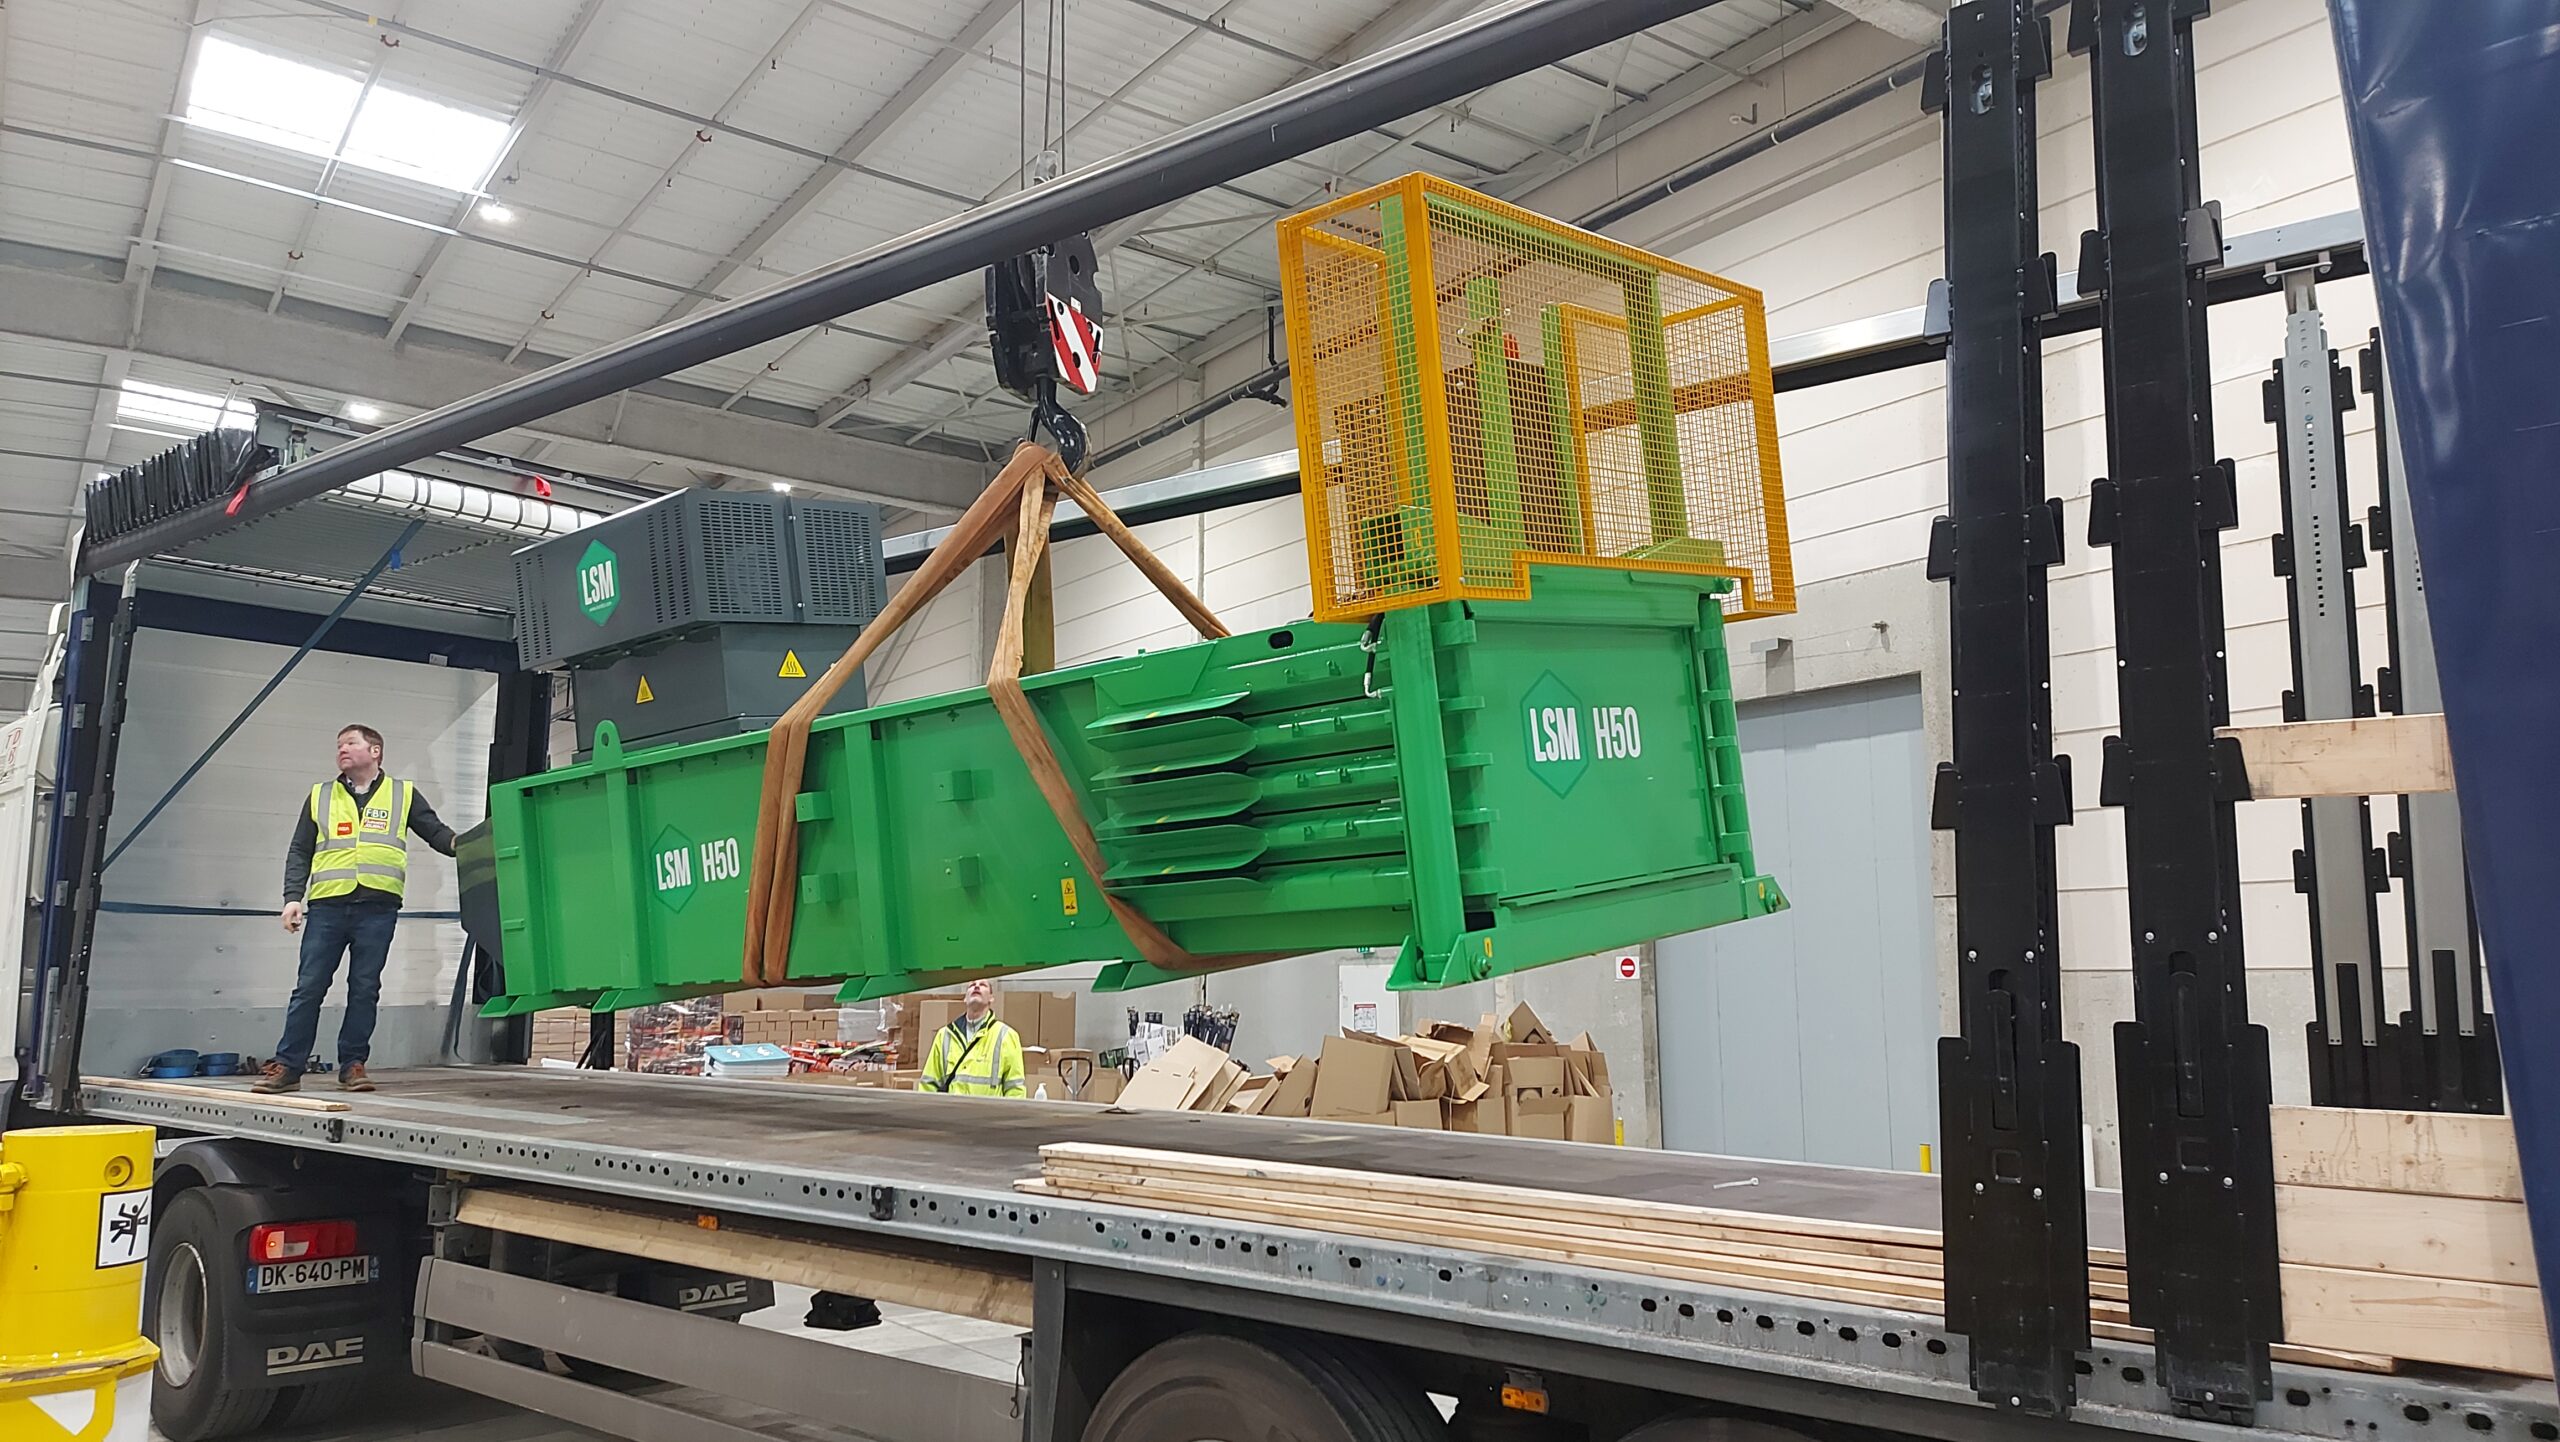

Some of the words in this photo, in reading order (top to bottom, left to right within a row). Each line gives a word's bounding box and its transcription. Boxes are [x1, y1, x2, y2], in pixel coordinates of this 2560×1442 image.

[581, 560, 615, 606] LSM
[1529, 707, 1581, 762] LSM
[1592, 706, 1641, 759] H50
[366, 808, 388, 819] FBD
[655, 847, 692, 891] LSM
[700, 837, 740, 882] H50
[262, 1258, 365, 1287] DK-640-PM
[679, 1280, 747, 1304] DAF
[266, 1336, 364, 1366] DAF
